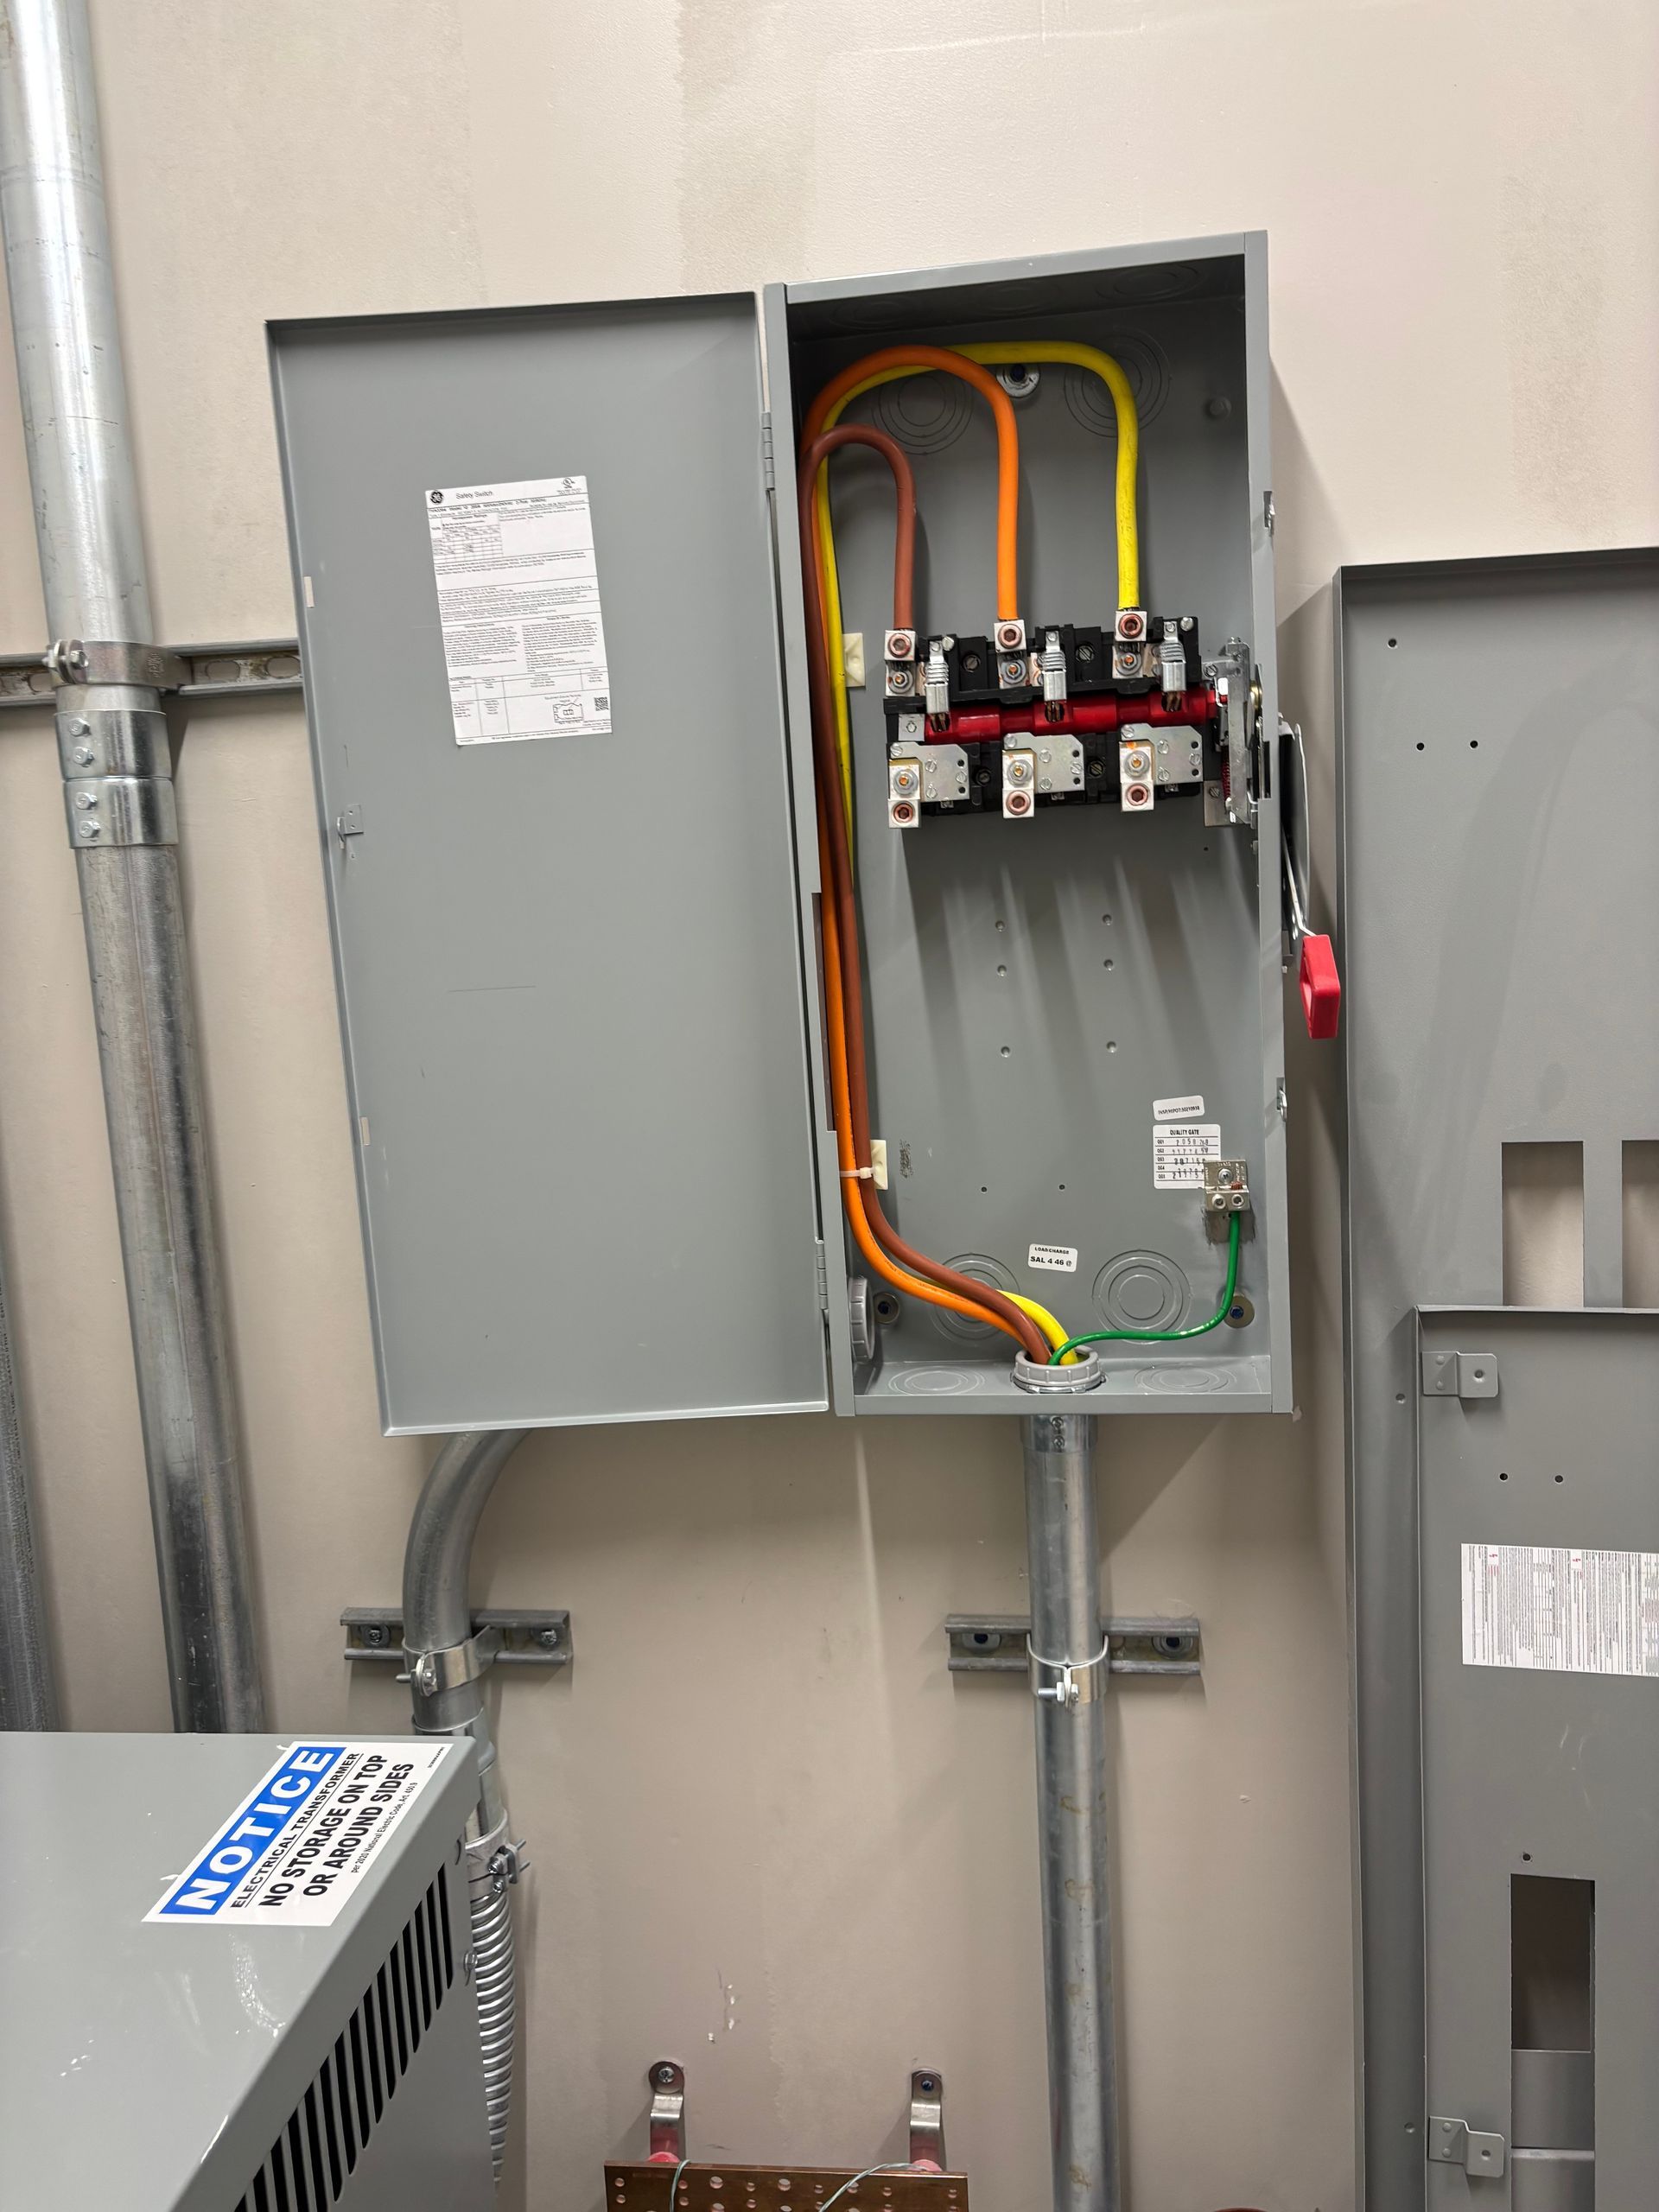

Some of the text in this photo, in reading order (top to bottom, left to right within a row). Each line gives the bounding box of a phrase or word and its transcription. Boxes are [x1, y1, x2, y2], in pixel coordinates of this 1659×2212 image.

[175, 1750, 334, 1910] NOTICE
[230, 1753, 360, 1908] ELECTRICAL TRANSFORMER
[258, 1755, 388, 1906] NO STORAGE ON TOP
[303, 1764, 414, 1897] OR AROUND SIDES
[364, 1833, 383, 1853] National
[377, 1815, 396, 1834] Electric
